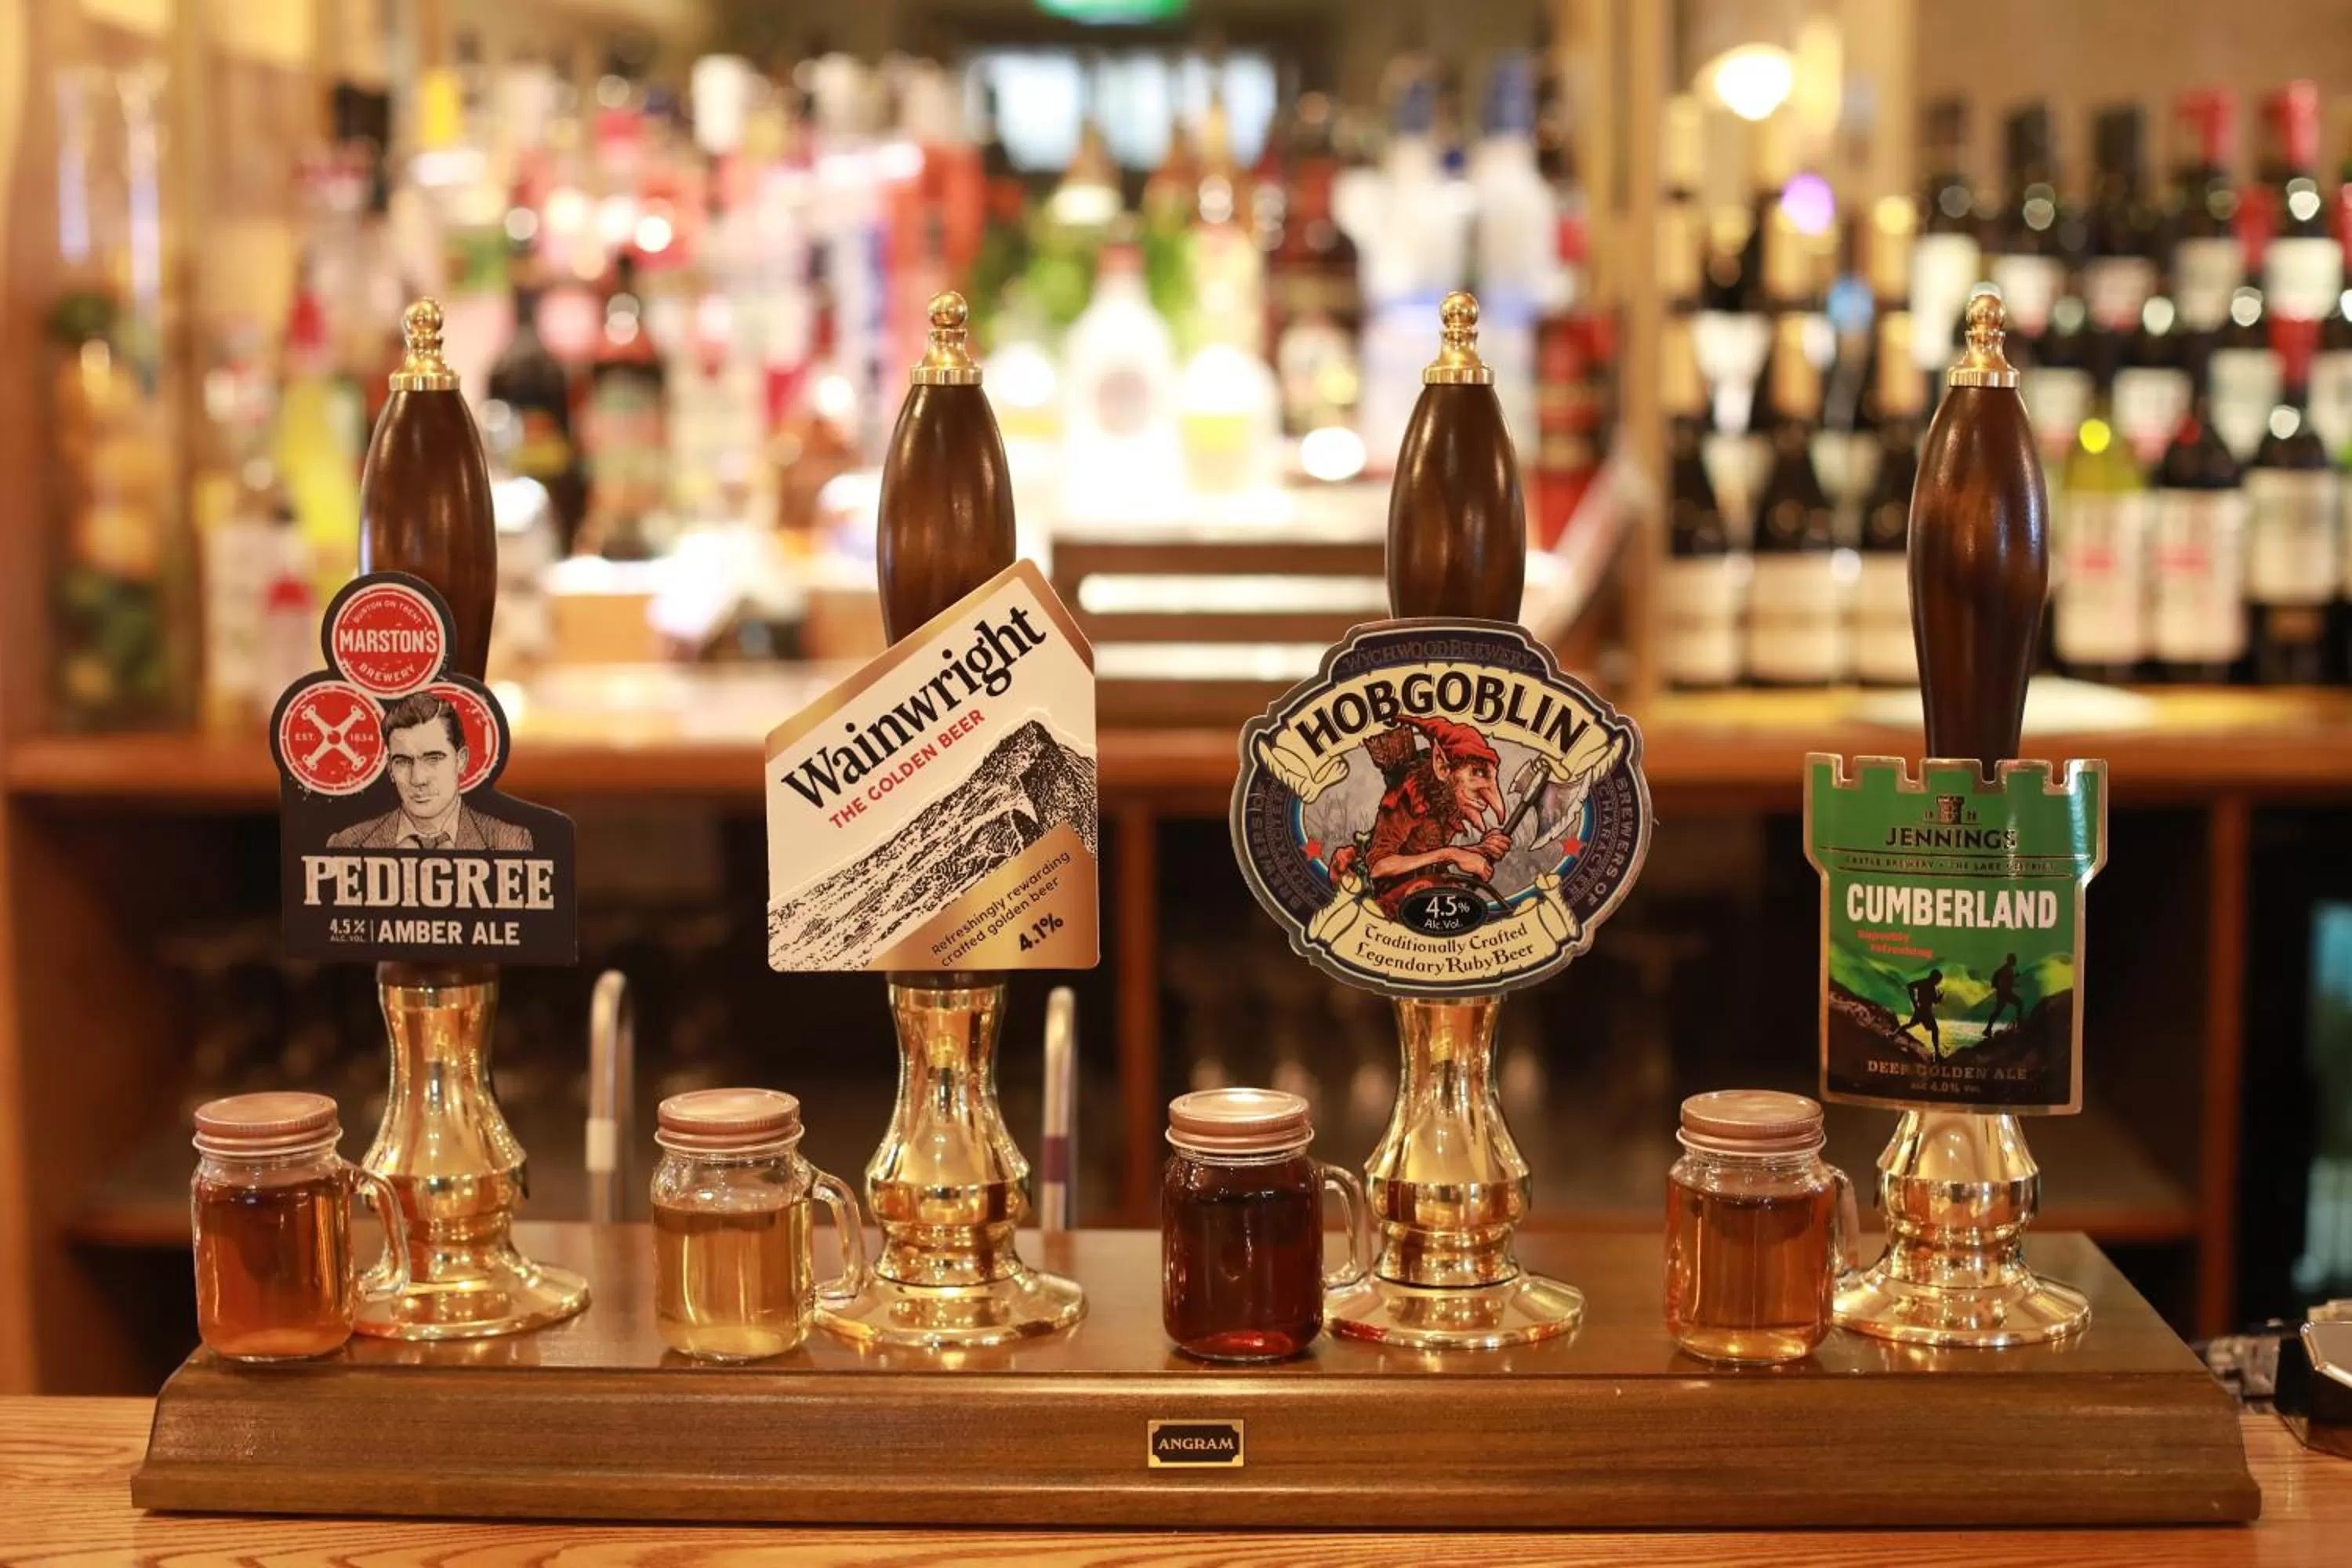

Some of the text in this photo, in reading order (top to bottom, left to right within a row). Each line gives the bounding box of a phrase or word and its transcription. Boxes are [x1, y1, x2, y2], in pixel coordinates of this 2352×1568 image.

[339, 626, 437, 653] MARSTON'S
[359, 662, 415, 682] BREWERY
[780, 605, 1047, 811] Wainwright
[1294, 671, 1592, 757] HOBGOBLIN
[350, 733, 374, 742] 1834
[828, 709, 986, 829] THE GOLDEN BEER
[1606, 777, 1633, 878] BREWERS
[1886, 826, 2017, 850] JENNINGS
[301, 855, 555, 910] PEDIGREE
[931, 852, 1071, 956] Refreshingly rewarding
[1425, 895, 1470, 919] 4.5%
[1846, 883, 2058, 930] CUMBERLAND
[377, 920, 521, 946] AMBER ALE
[942, 877, 1060, 967] crafted golden beer
[1018, 913, 1064, 952] 4.1%
[1365, 922, 1528, 956] Traditionally Crafted
[1355, 941, 1534, 976] Legendary Ruby Beer
[1993, 1066, 2027, 1080] ALE
[1158, 1437, 1236, 1450] ANGRAM
